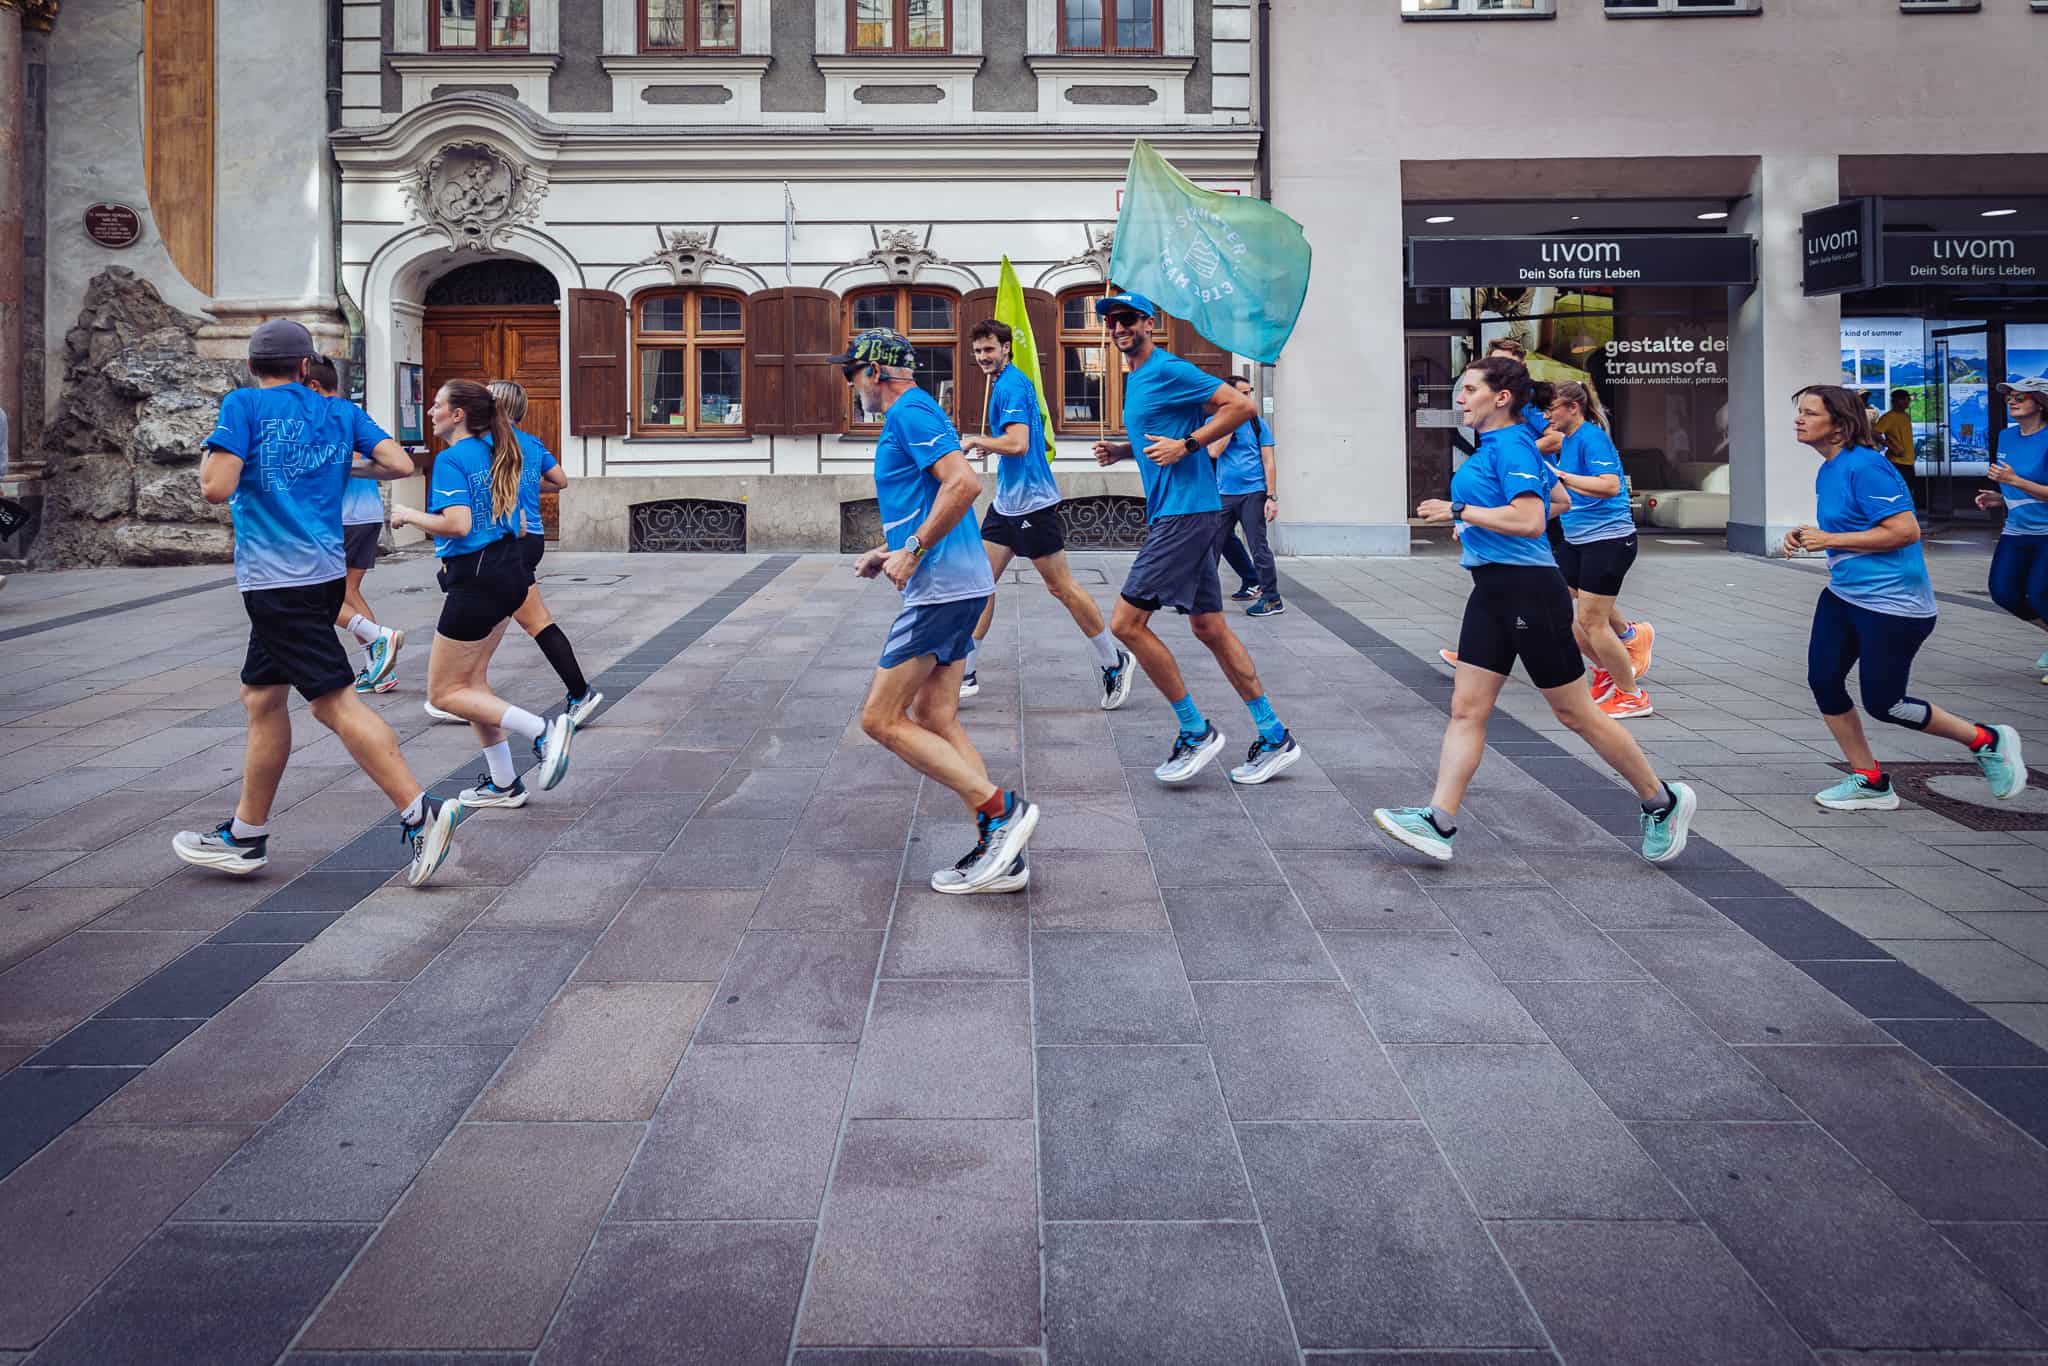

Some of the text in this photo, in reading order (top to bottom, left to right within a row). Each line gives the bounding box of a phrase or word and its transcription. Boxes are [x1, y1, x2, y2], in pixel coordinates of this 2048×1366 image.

[1519, 267, 1641, 279] Dein Sofa fürs Leben
[1910, 264, 2036, 276] Dein Sofa fürs Leben
[1845, 329, 1860, 337] kind
[1862, 329, 1870, 337] of
[1605, 336, 1695, 357] gestalte
[1605, 357, 1718, 374] traumsofa
[1605, 376, 1646, 385] modular,
[260, 418, 305, 442] FLY
